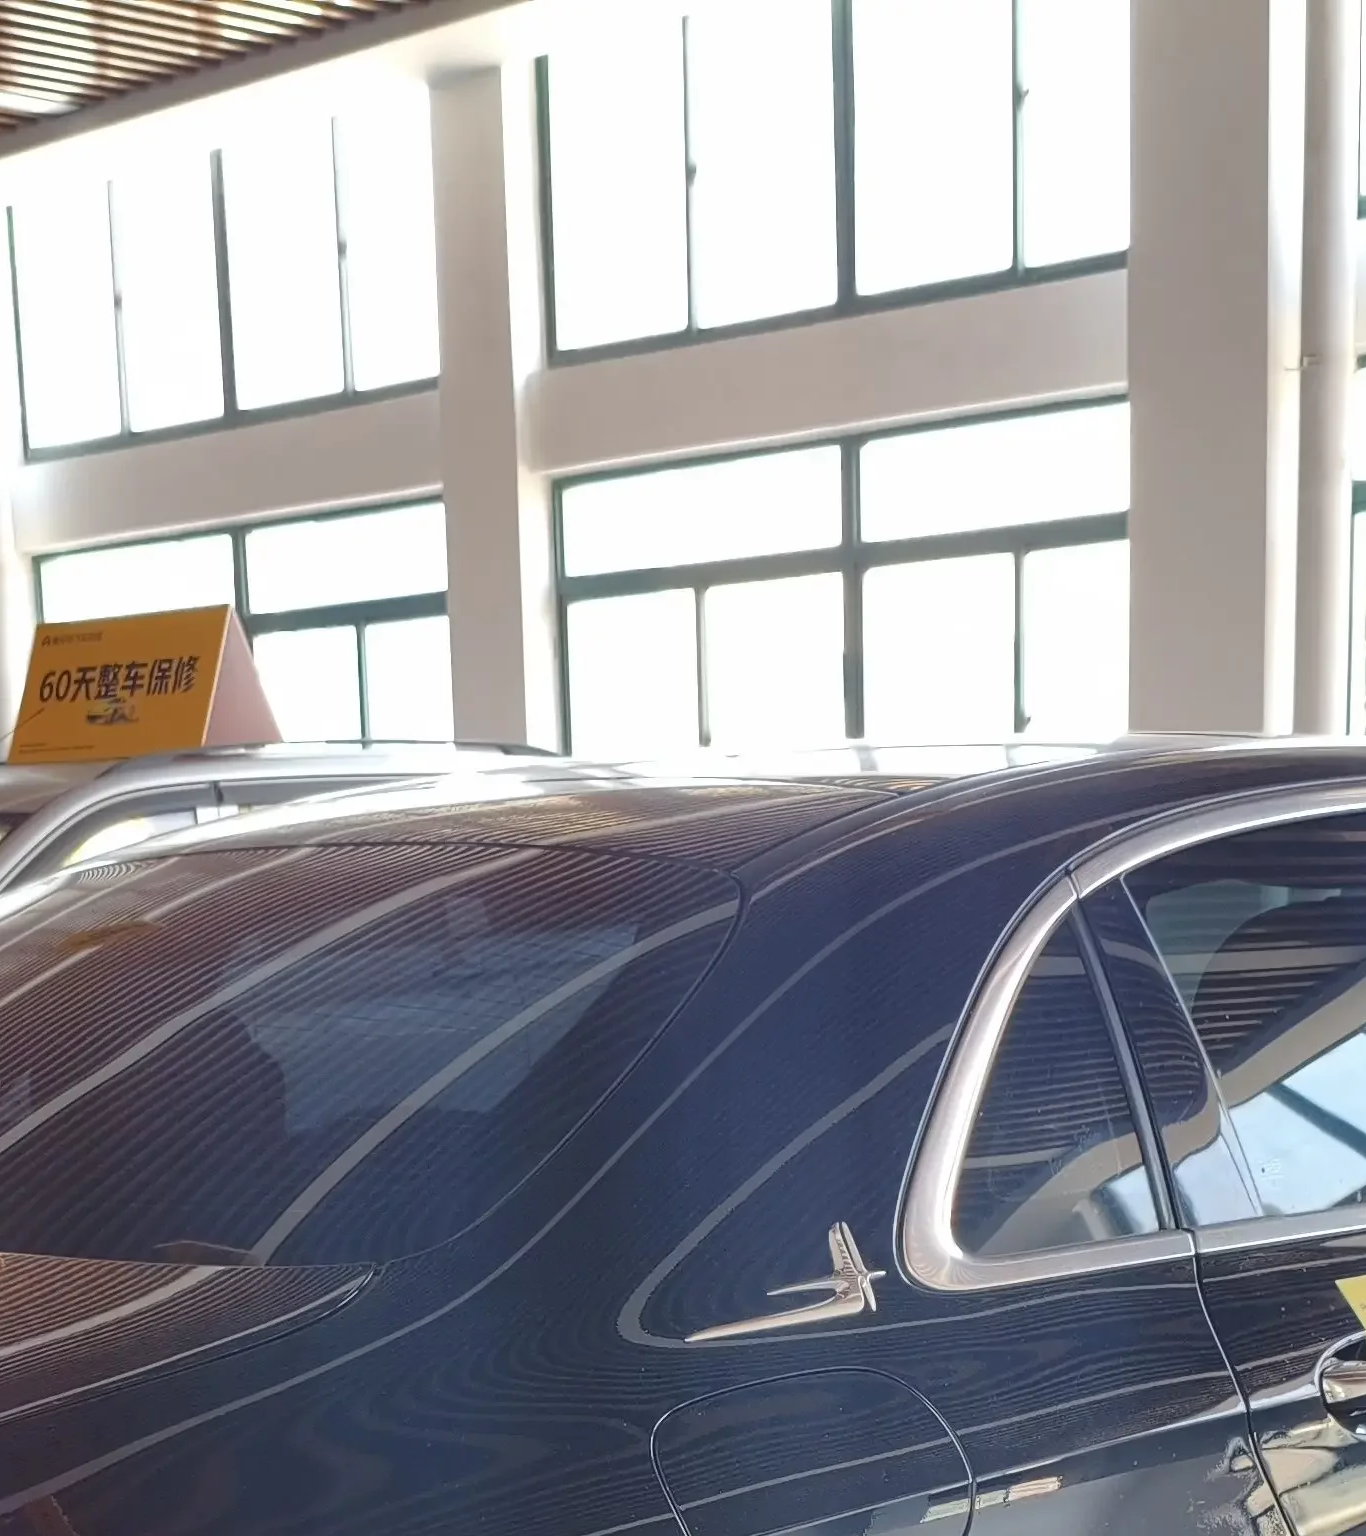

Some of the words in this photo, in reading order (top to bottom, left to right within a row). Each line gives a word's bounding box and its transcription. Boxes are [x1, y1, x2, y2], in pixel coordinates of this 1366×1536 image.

[39, 655, 200, 703] 60天整车保修
